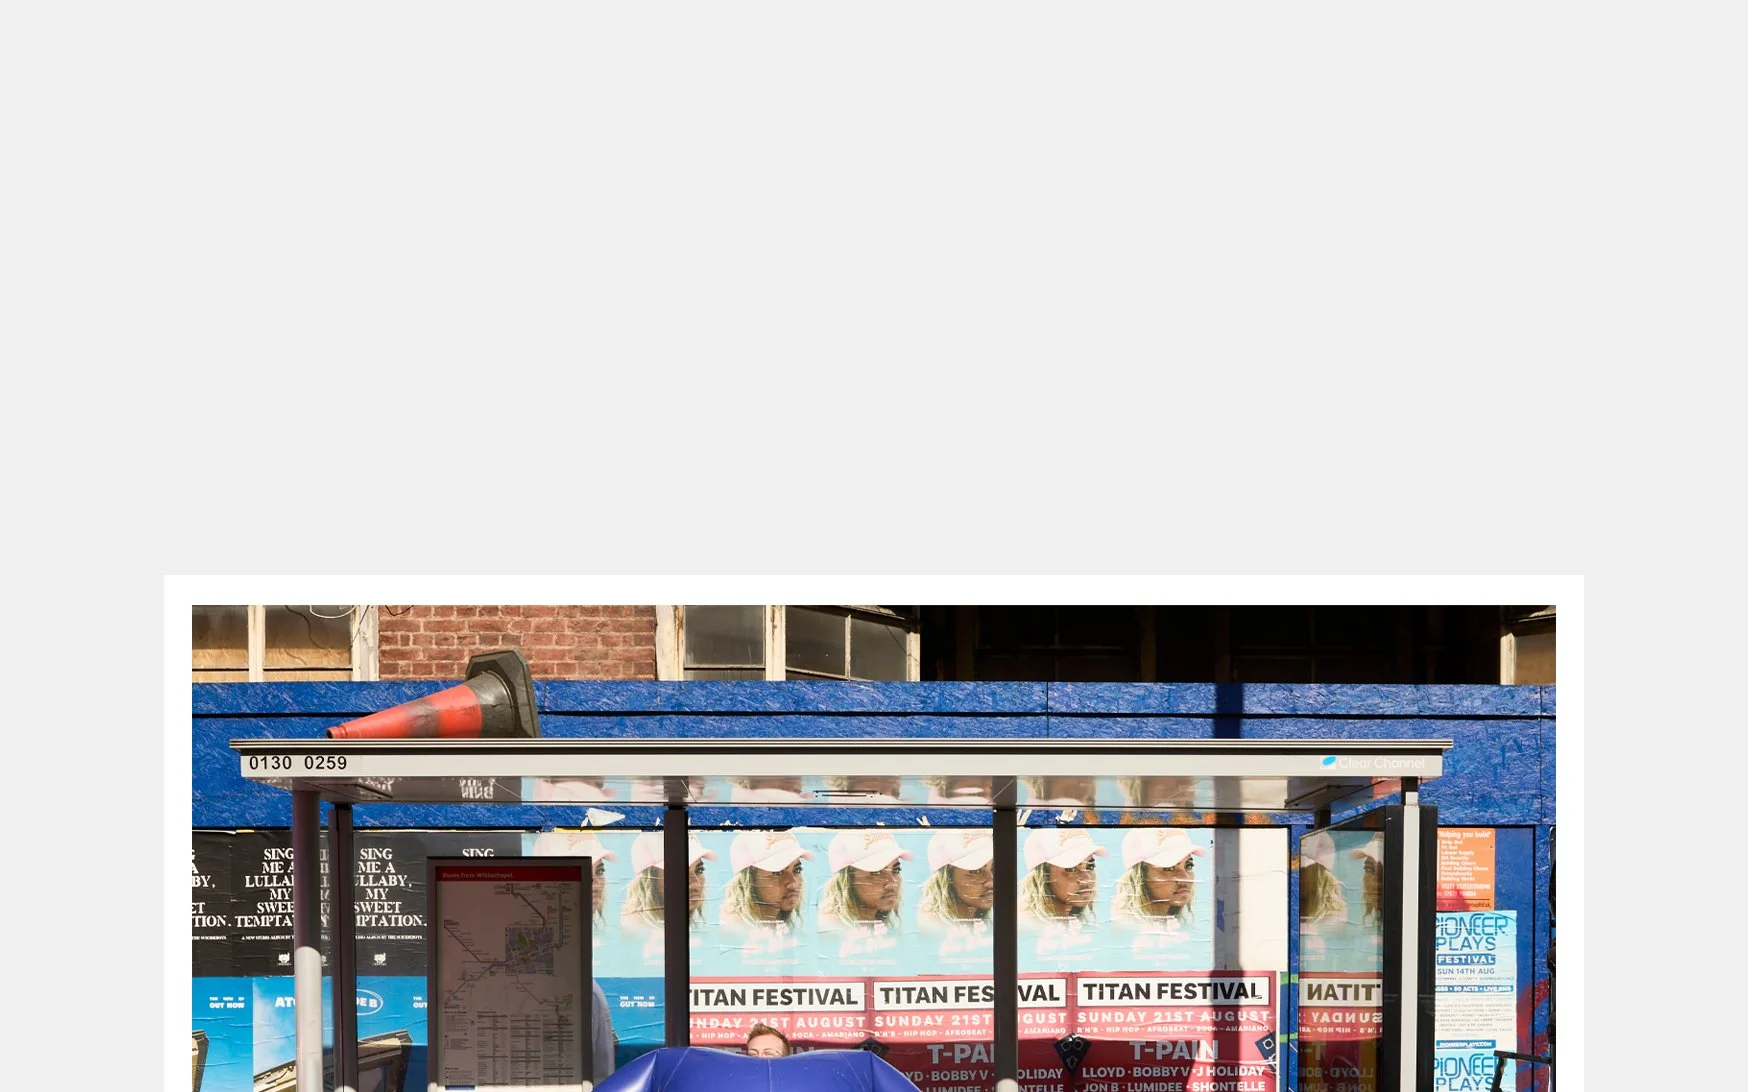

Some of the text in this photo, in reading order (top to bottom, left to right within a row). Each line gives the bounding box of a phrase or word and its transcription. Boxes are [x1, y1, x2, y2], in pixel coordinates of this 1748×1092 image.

[249, 755, 347, 770] 0130 0259
[1338, 757, 1425, 769] Clear Channel
[264, 848, 294, 860] SING
[360, 848, 392, 860] SING
[262, 862, 284, 874] ME
[358, 862, 396, 874] ME A
[245, 875, 294, 888] LULLA
[269, 888, 292, 900] MY
[365, 888, 388, 900] MY
[257, 902, 294, 914] SWEE
[354, 902, 402, 914] SWEET
[1436, 936, 1496, 951] PLAYS
[1438, 956, 1495, 964] FESTIVAL
[690, 988, 858, 1006] ITAN FESTIVAL
[880, 984, 1060, 1005] TITAN FESVAL
[1083, 982, 1262, 1000] TITAN FESTIVAL
[796, 1016, 866, 1028] AUGUST
[874, 1012, 1066, 1028] SUNDAY 21ST GUST
[1078, 1011, 1270, 1023] SUNDAY 21ST AUGUST
[1129, 1040, 1218, 1061] T-PAIN
[931, 1068, 1063, 1080] BOBBY V OLIDAY
[1082, 1066, 1266, 1078] LLOYD BOBBY V J HOLIDAY
[1083, 1082, 1266, 1092] JON B LUMIDEE SHONTELLE
[1436, 1077, 1494, 1092] PLAYS
